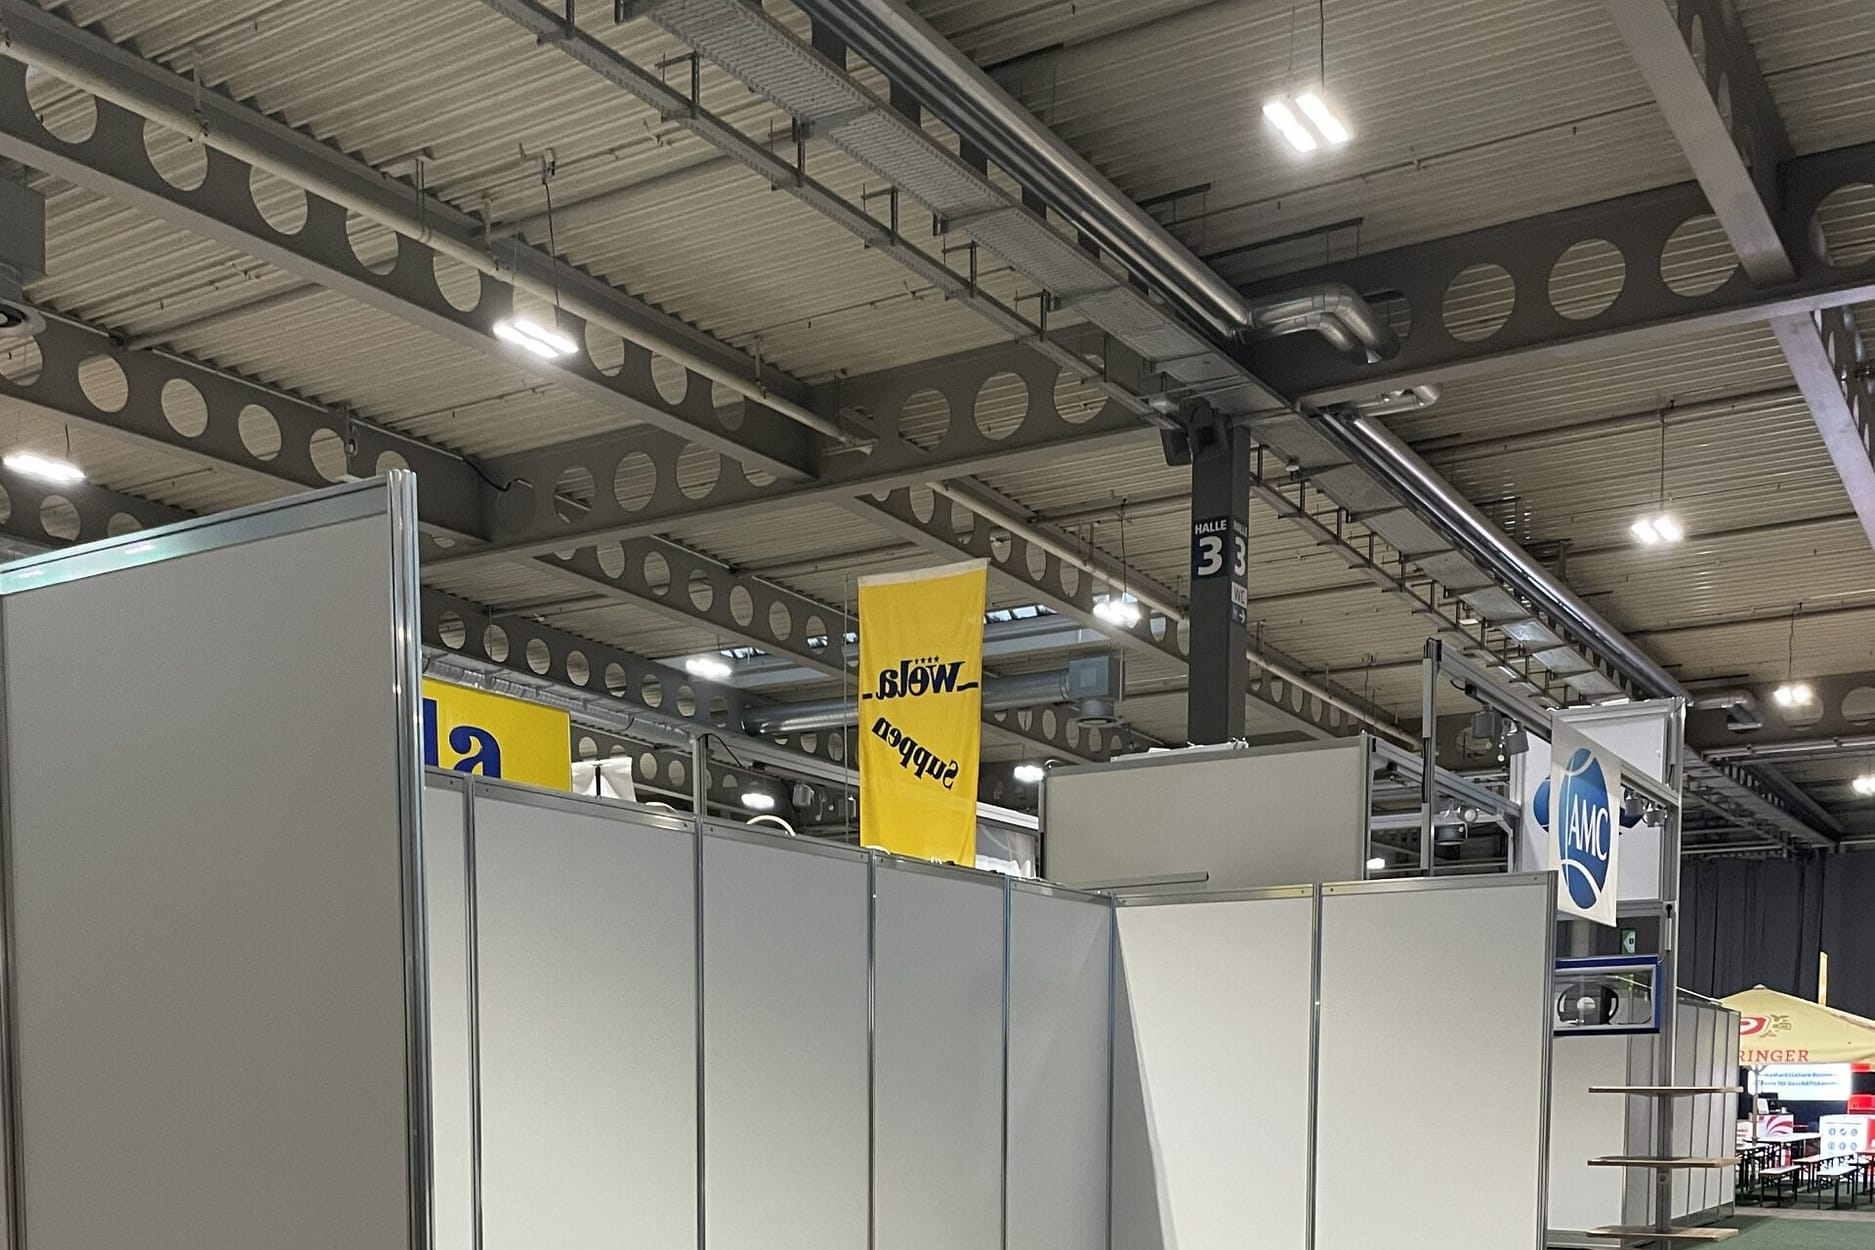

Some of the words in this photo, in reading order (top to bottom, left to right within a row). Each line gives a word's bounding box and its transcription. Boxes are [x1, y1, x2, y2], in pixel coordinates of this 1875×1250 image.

[1194, 519, 1227, 535] HALLE
[1198, 536, 1223, 576] 3
[1234, 536, 1246, 576] 3
[1567, 793, 1609, 861] AMC
